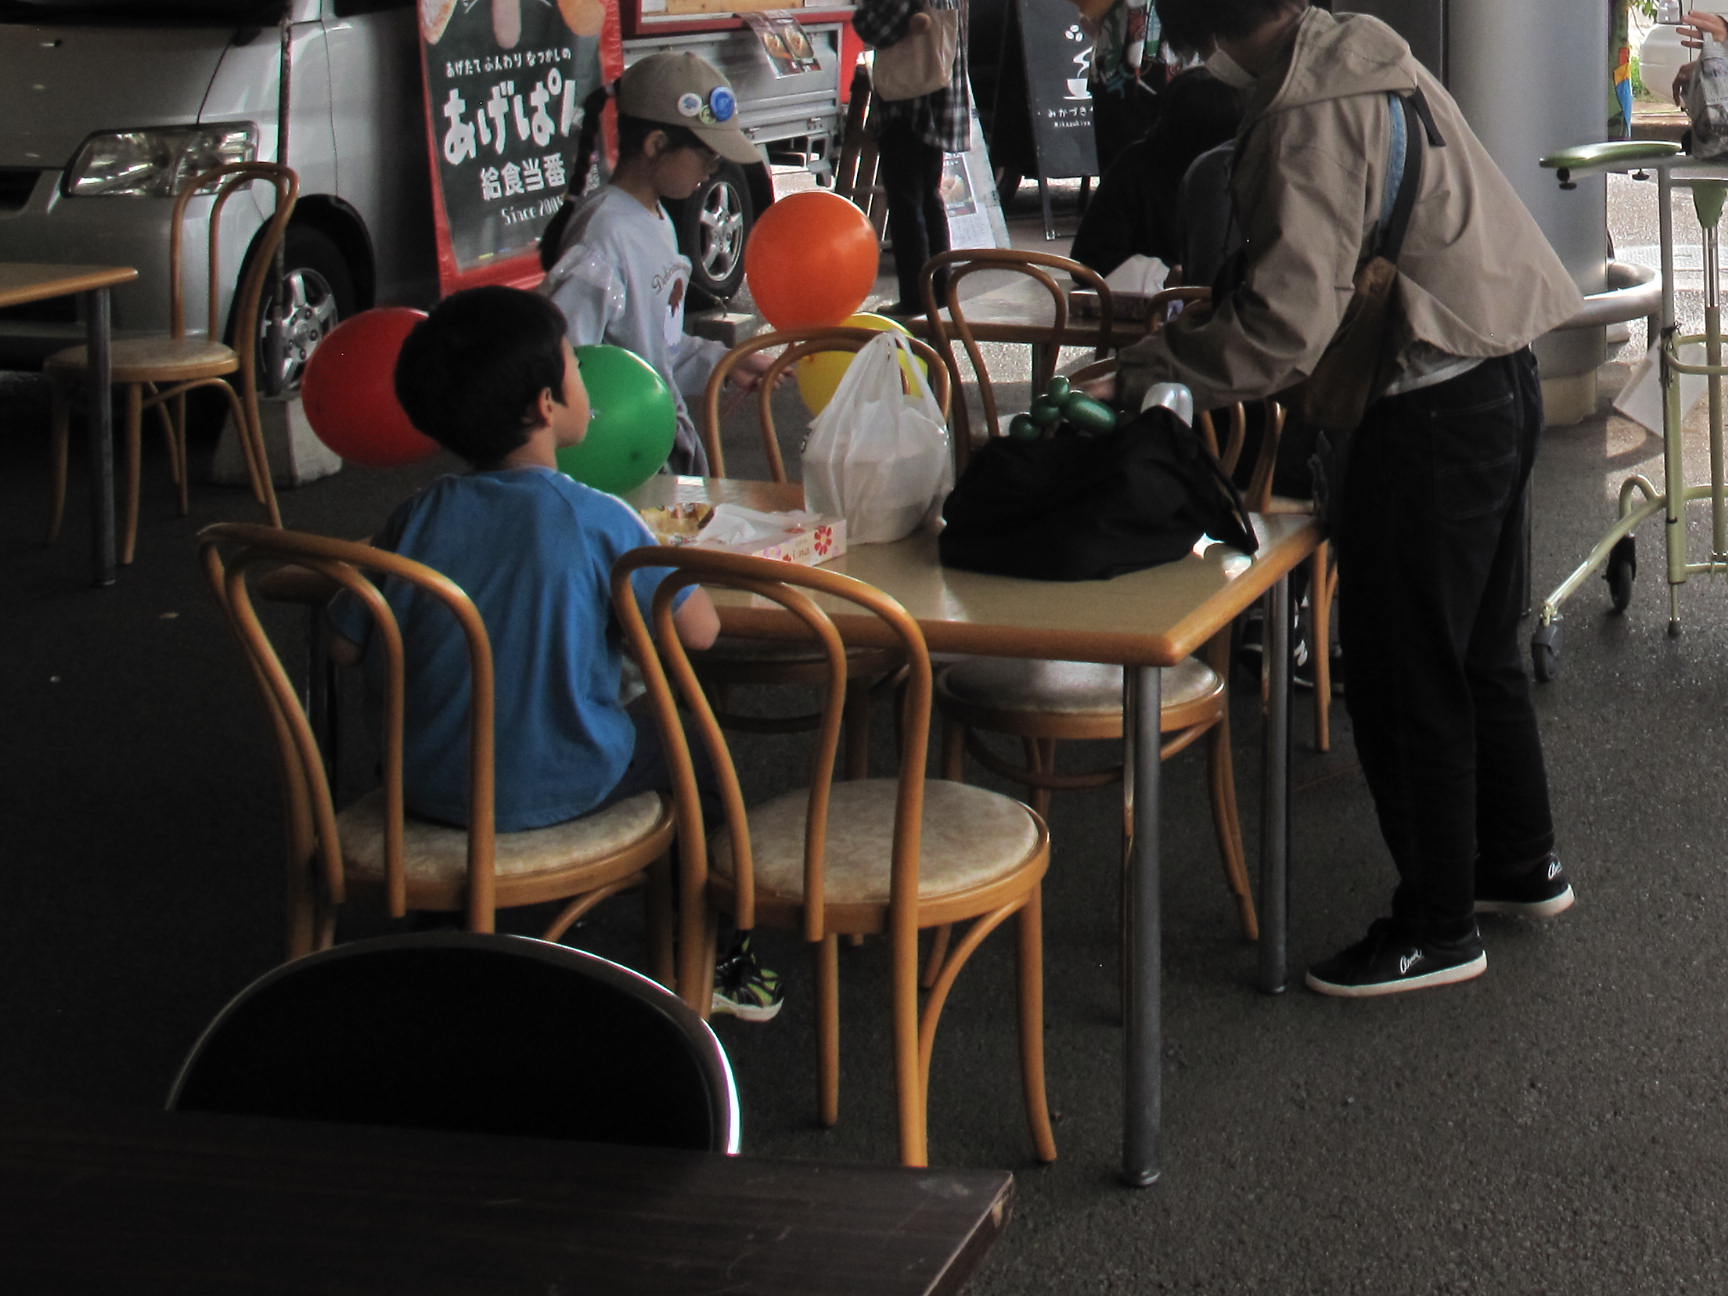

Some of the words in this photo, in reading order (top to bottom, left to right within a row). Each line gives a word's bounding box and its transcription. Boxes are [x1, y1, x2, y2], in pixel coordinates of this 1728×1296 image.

[445, 59, 481, 78] あげたて
[484, 53, 522, 72] ふんわり
[480, 152, 566, 201] 給食当番
[501, 206, 538, 225] Since
